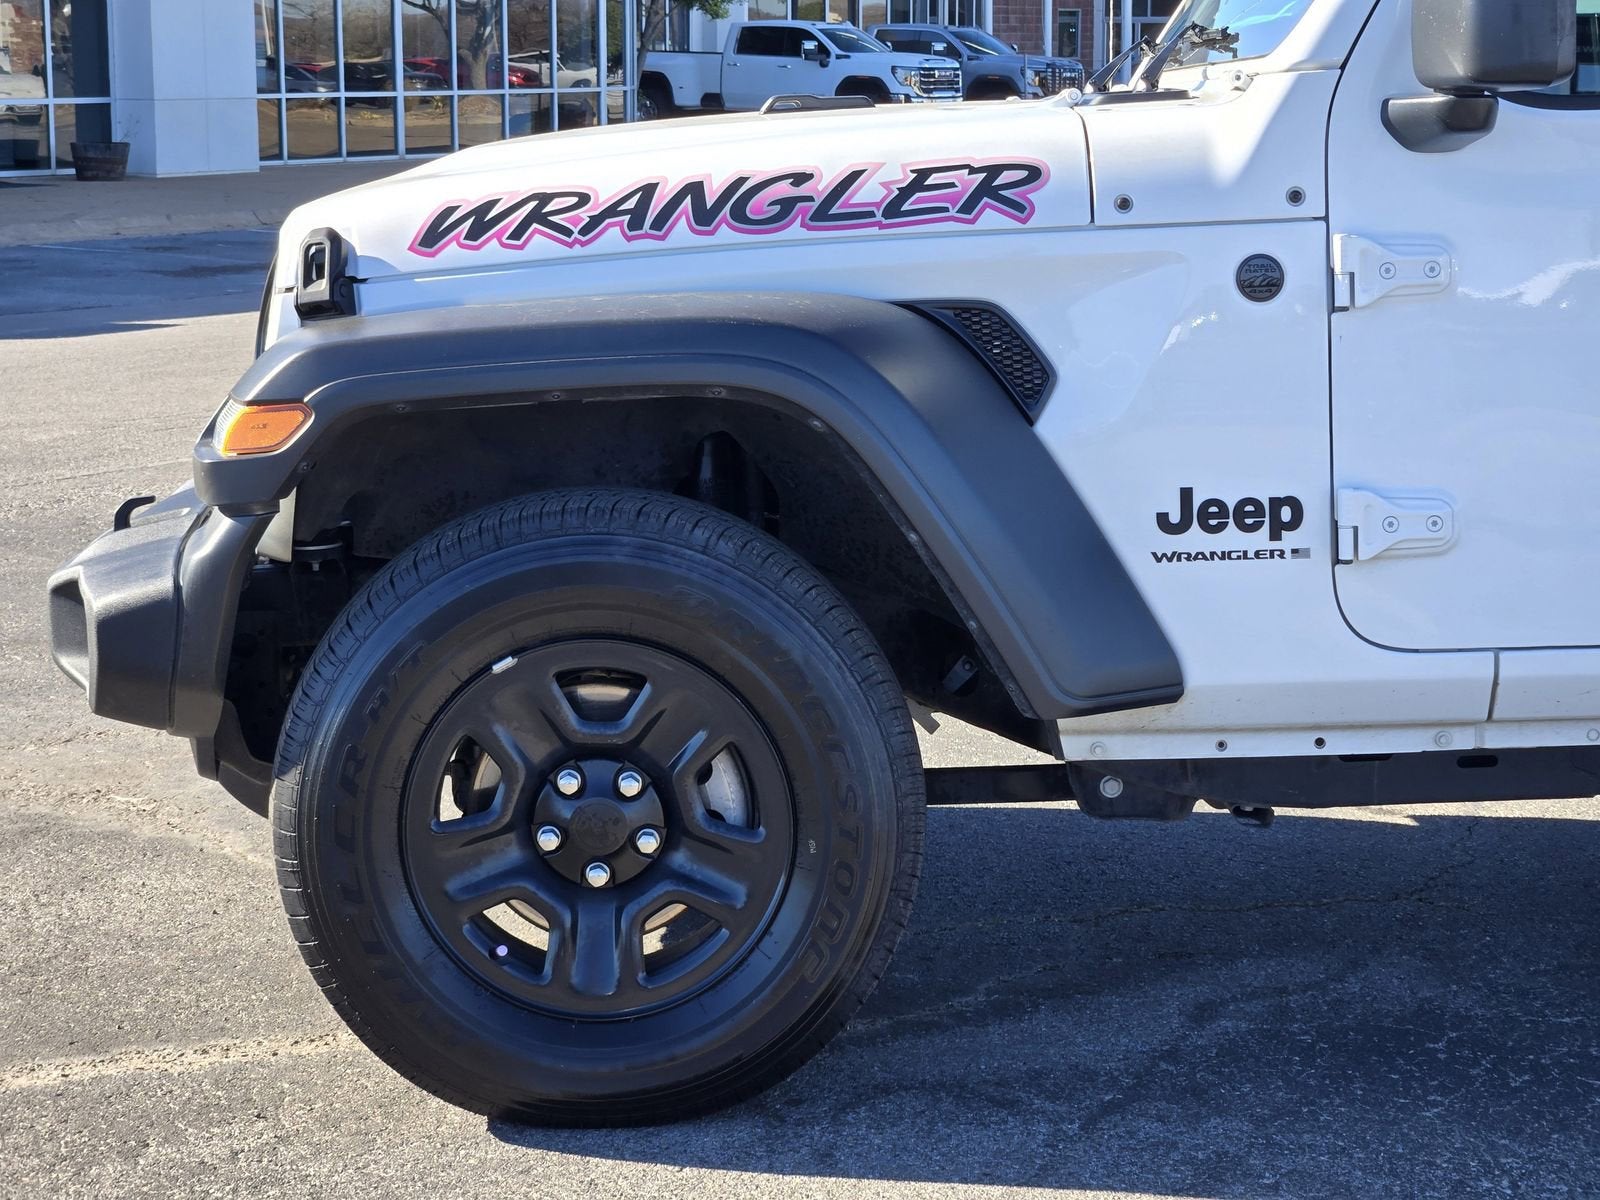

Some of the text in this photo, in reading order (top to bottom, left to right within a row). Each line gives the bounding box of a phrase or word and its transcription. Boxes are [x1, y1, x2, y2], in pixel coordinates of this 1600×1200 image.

[411, 158, 1047, 256] WRANGLER
[1155, 486, 1305, 542] Jeep
[1150, 549, 1287, 564] WRANGLER
